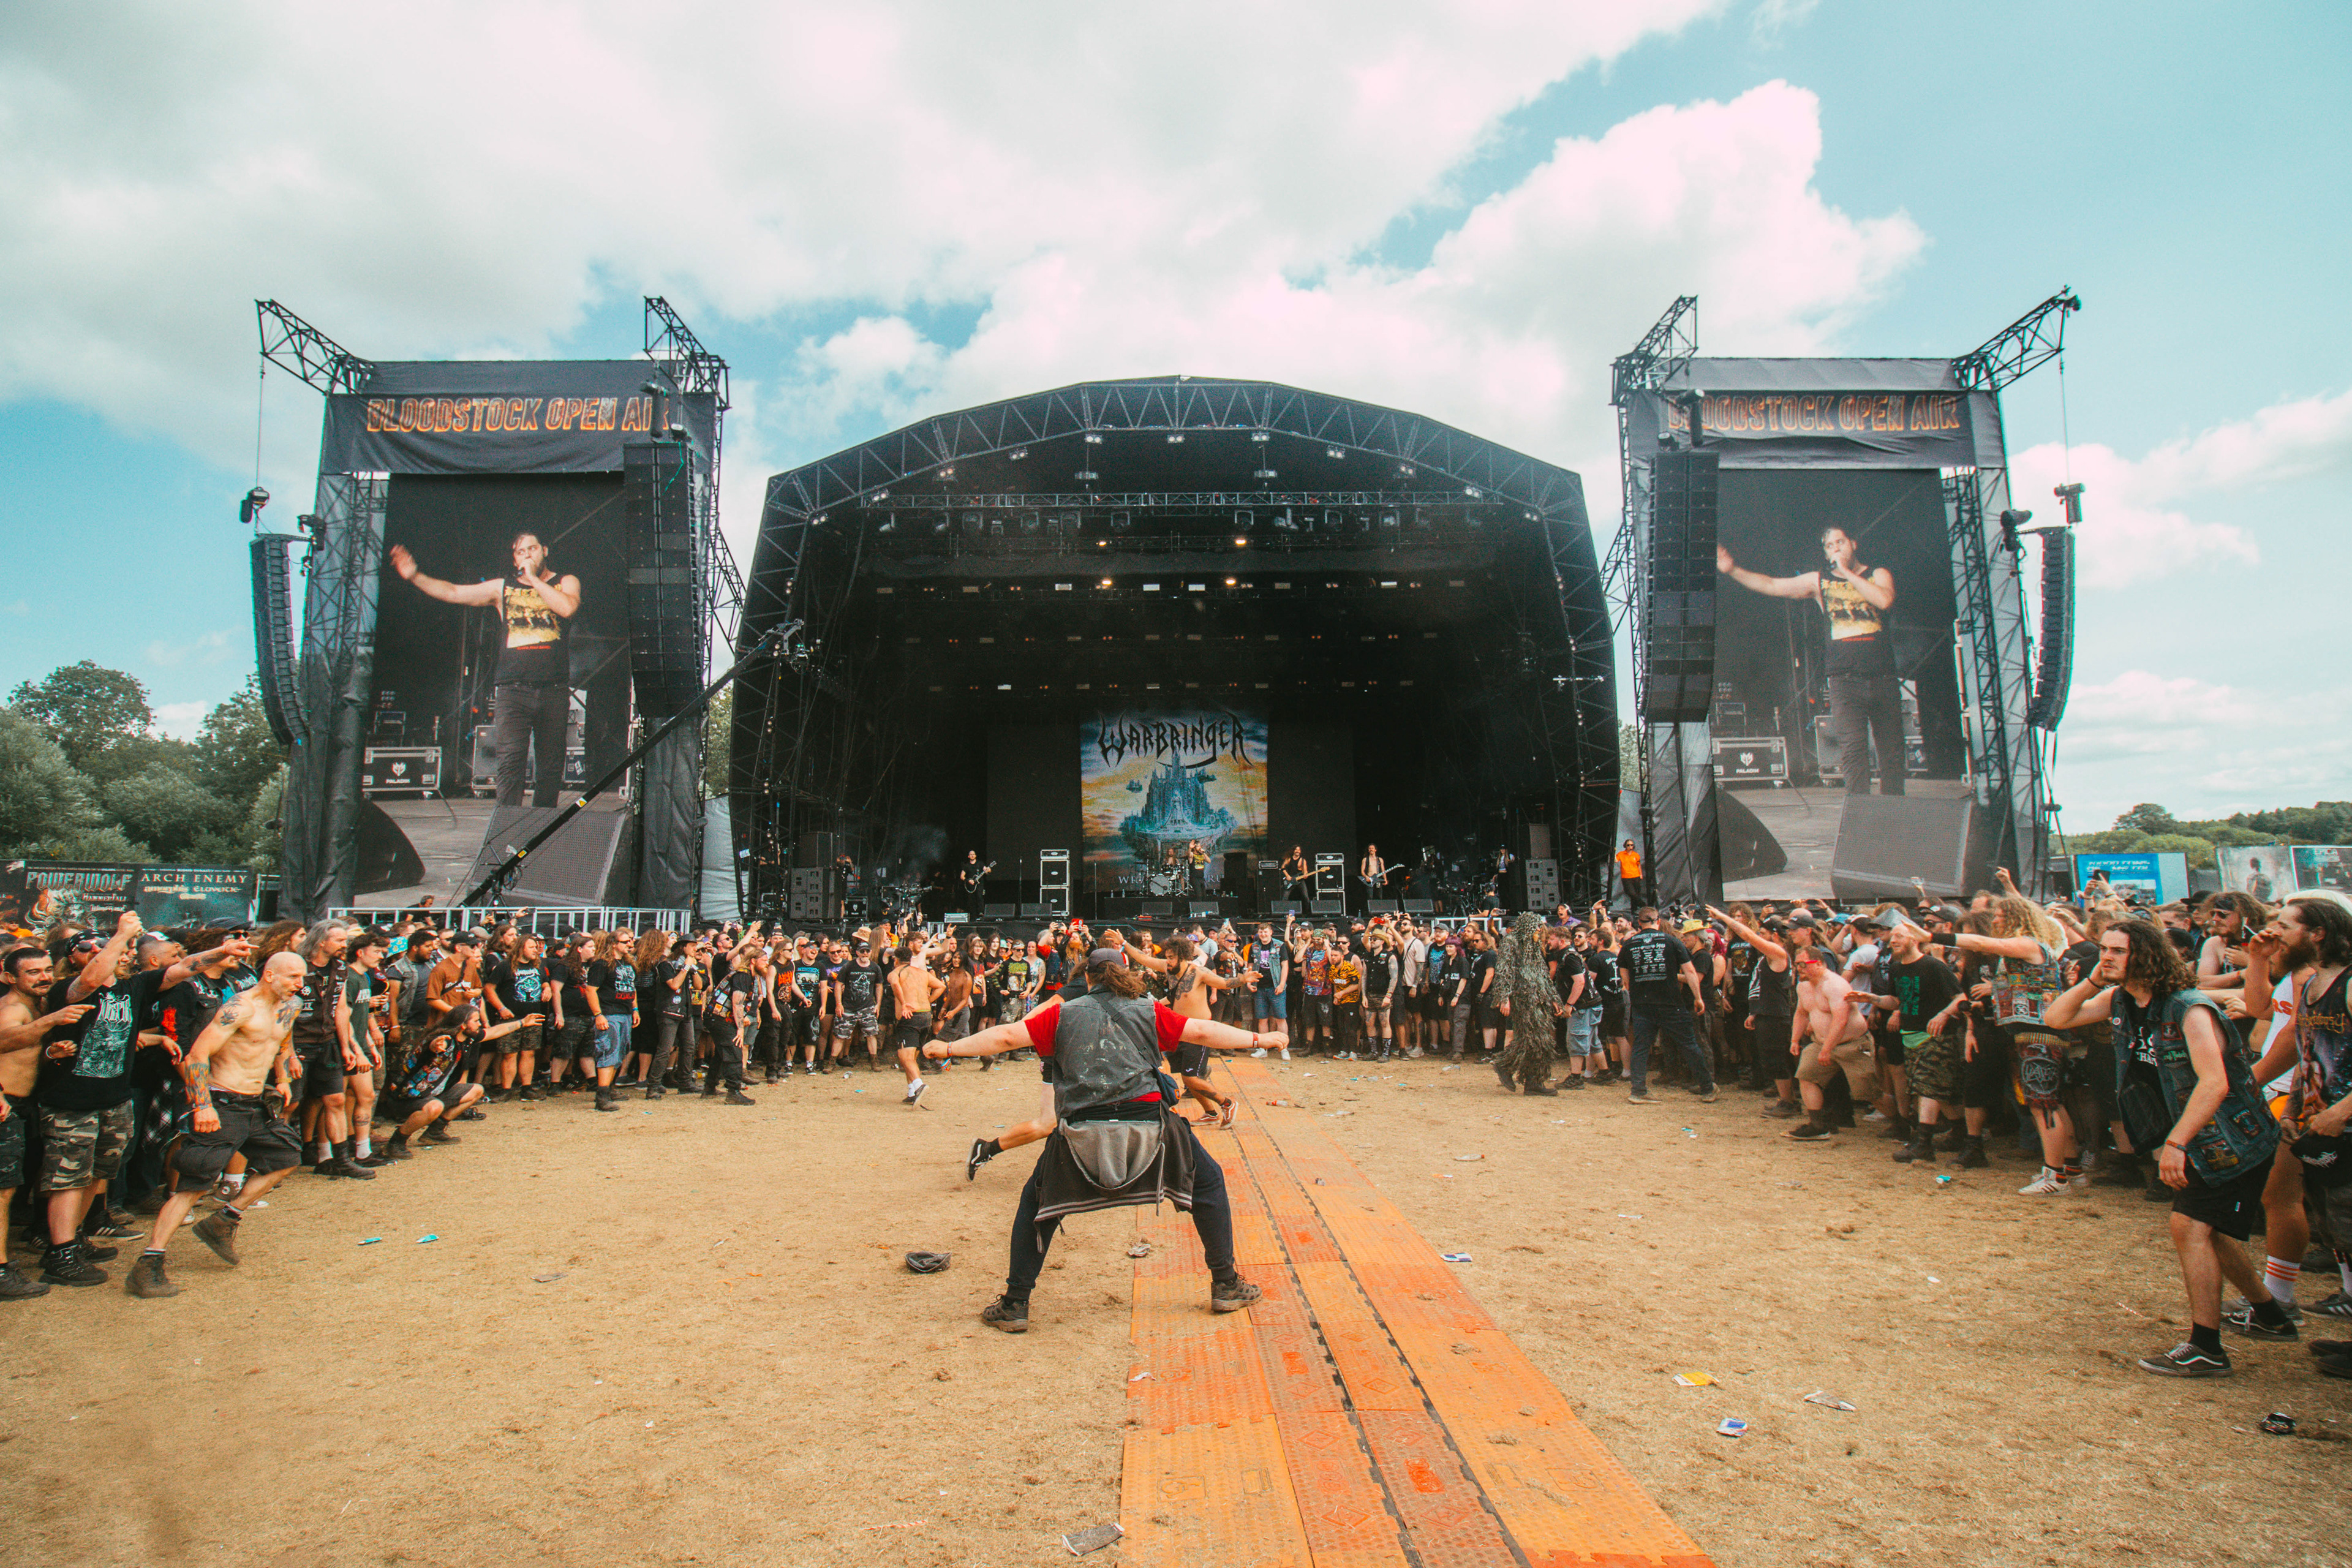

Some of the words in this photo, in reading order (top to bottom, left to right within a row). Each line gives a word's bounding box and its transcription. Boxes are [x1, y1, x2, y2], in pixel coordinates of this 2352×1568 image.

[368, 398, 543, 432] BLOODSTOCK
[546, 397, 618, 431] OPEN
[1839, 395, 1905, 431] OPEN
[1910, 395, 1961, 431] AIR
[26, 872, 133, 892] POWERWOLF
[141, 873, 186, 882] ARCH
[194, 874, 248, 883] ENEMY
